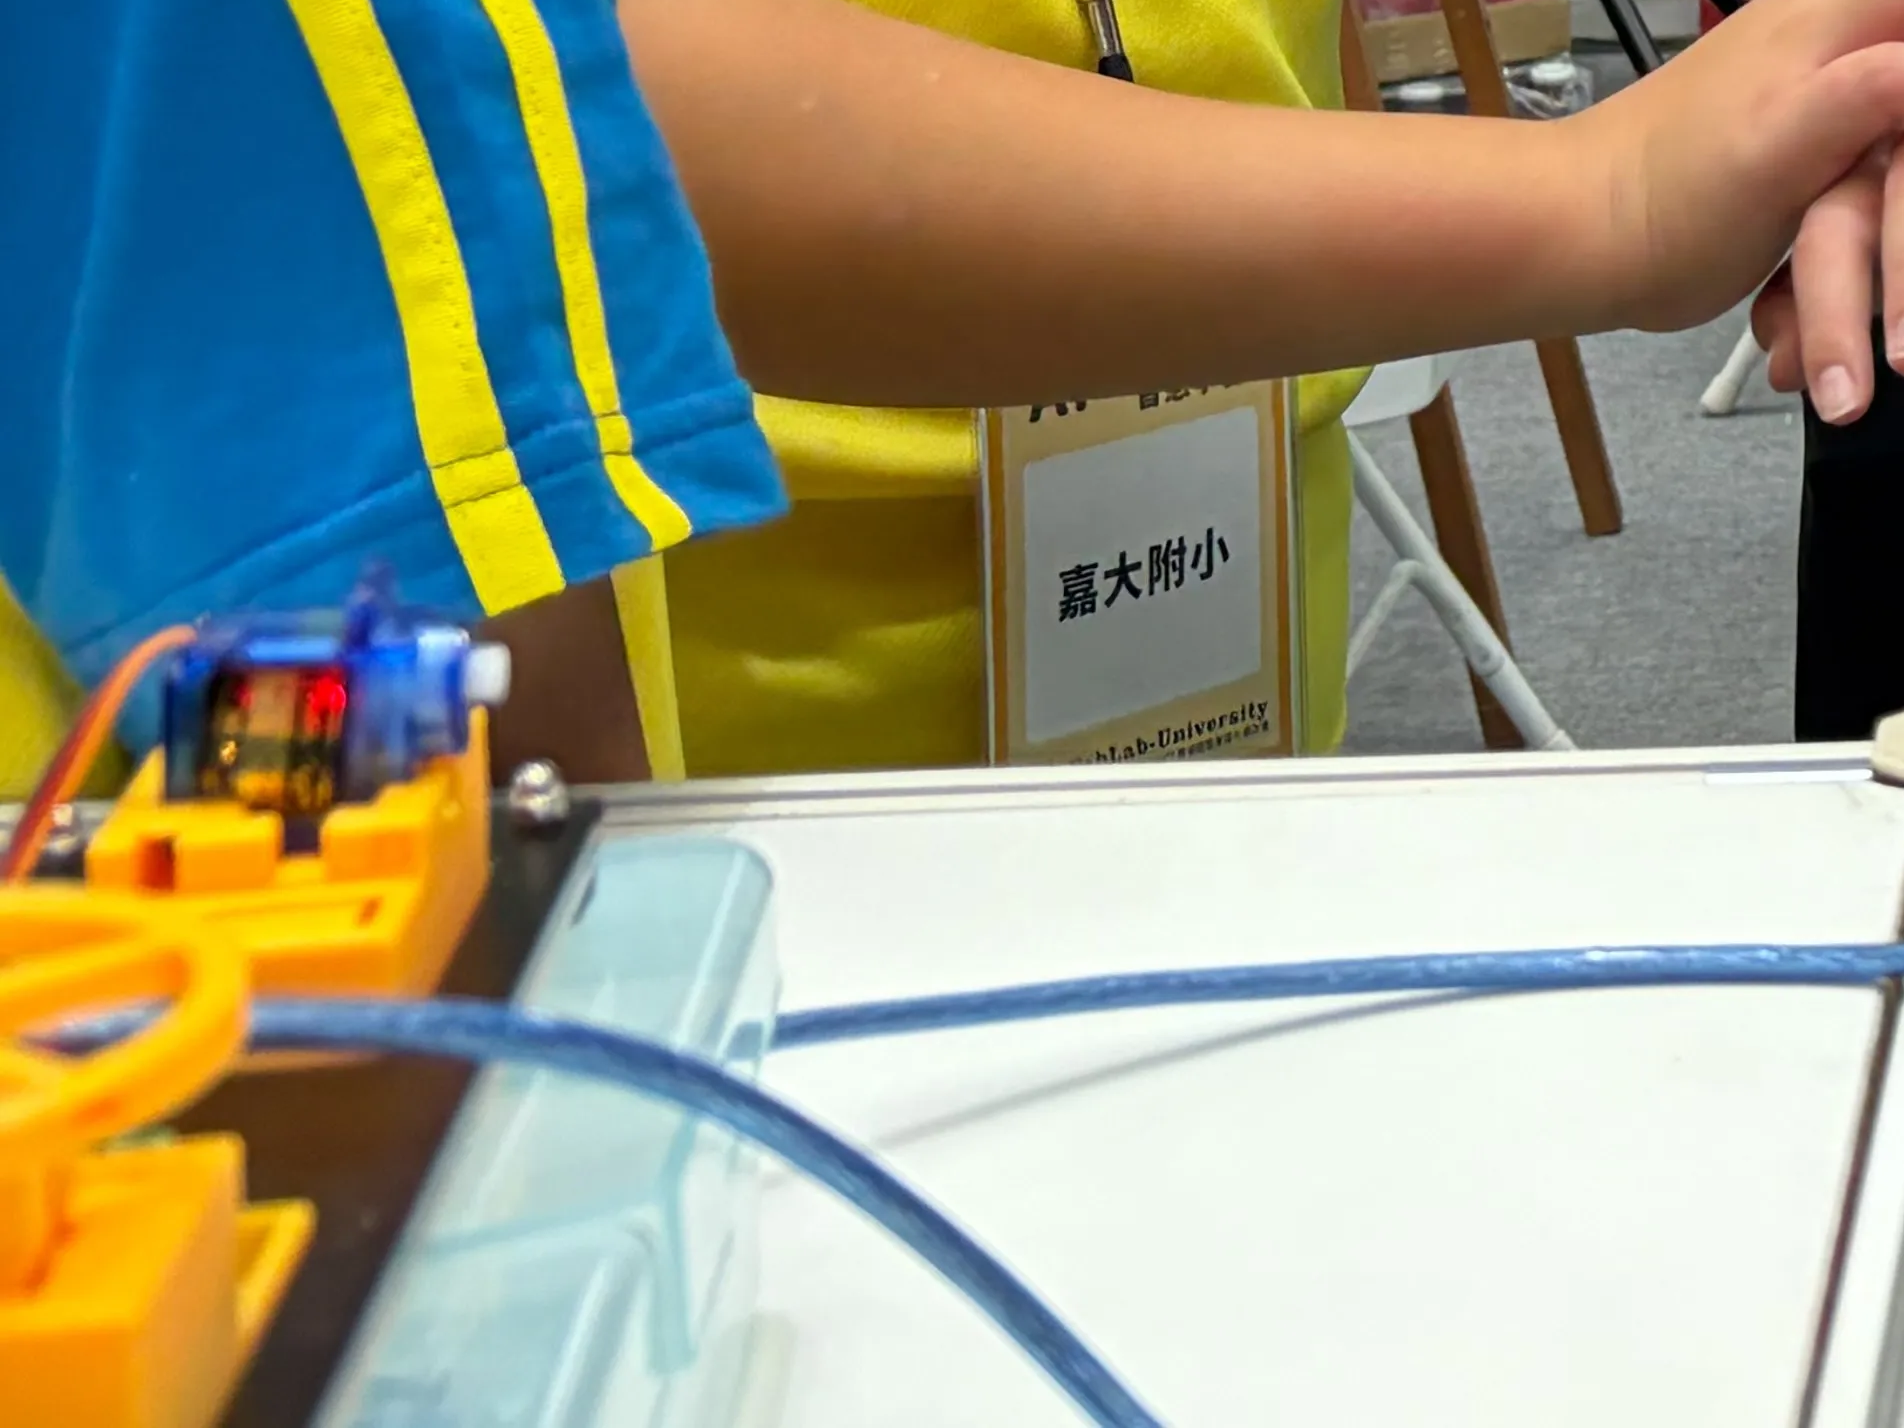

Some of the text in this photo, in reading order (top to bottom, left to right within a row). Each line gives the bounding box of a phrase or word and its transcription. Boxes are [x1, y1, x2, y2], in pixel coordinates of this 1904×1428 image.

[1058, 527, 1230, 623] 嘉大附小
[1069, 700, 1268, 764] bLab-University
